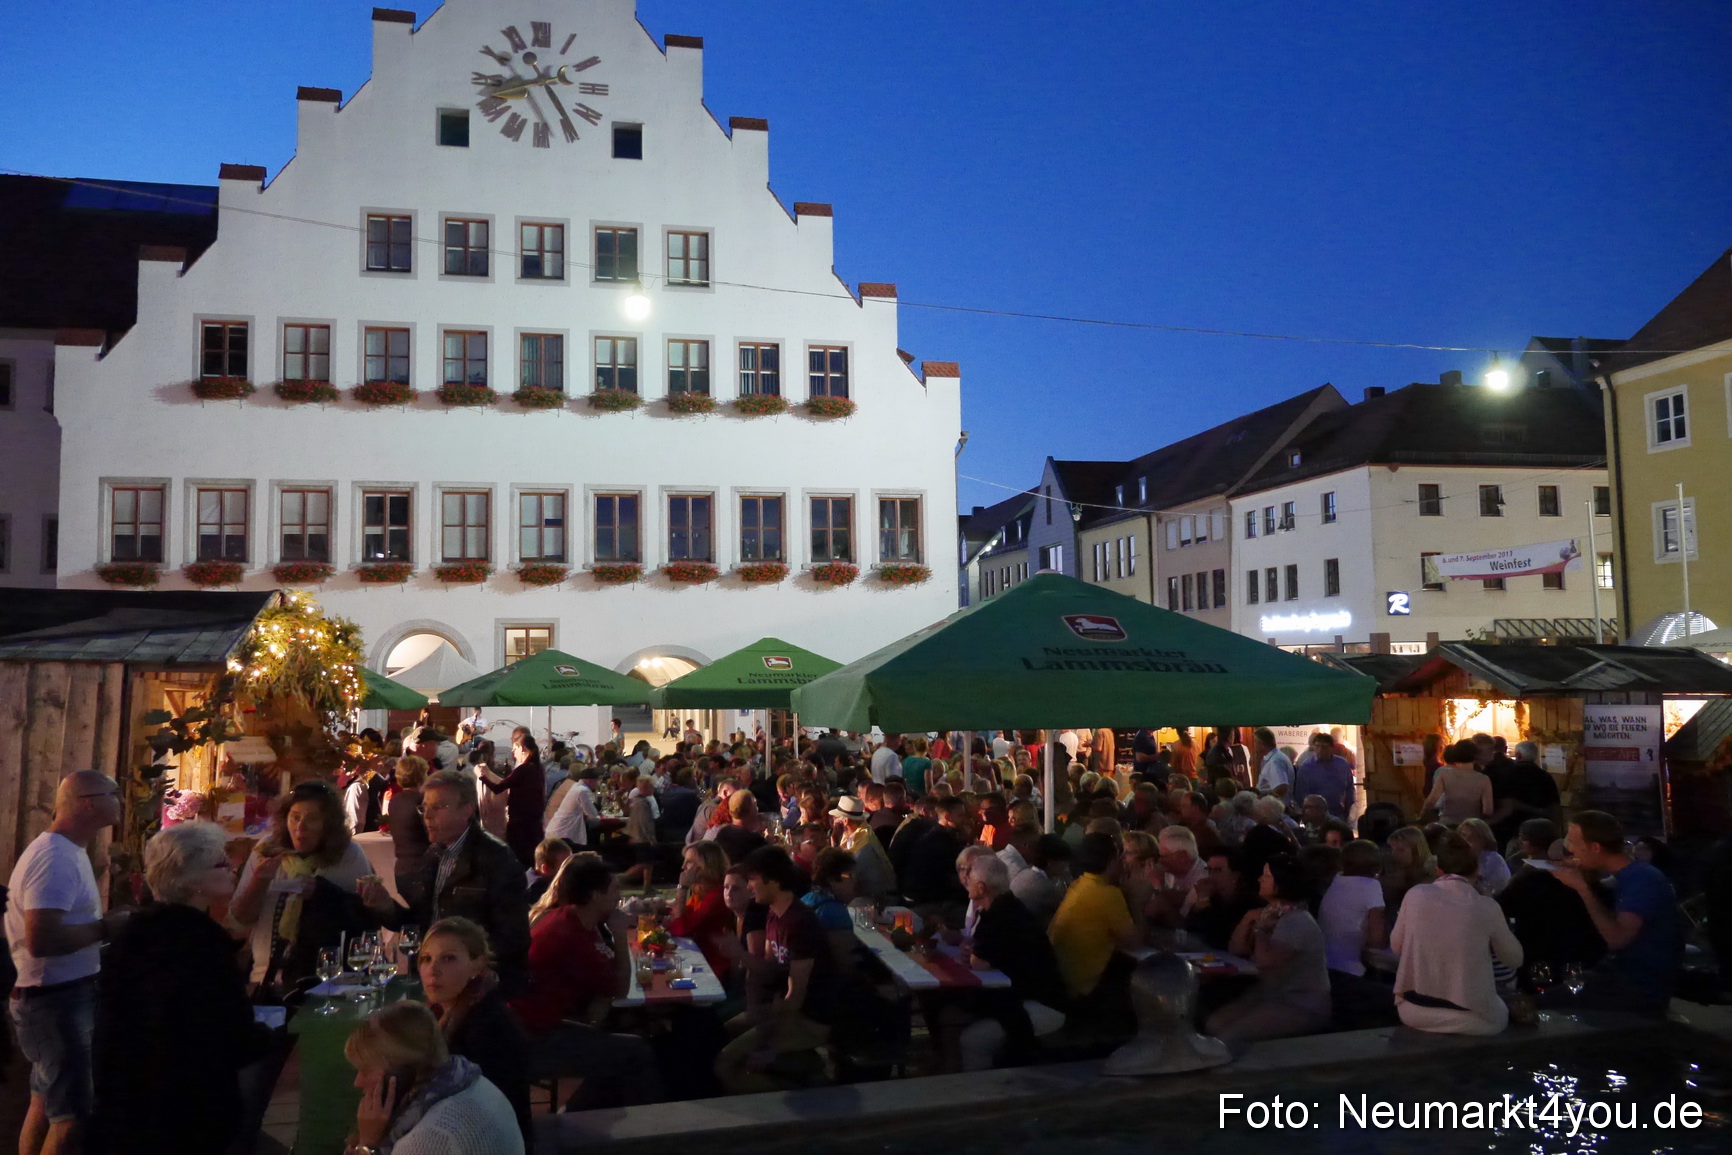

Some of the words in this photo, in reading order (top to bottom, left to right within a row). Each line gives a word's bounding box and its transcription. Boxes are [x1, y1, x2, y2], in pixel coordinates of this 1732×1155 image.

[1448, 555, 1459, 563] und
[1466, 553, 1497, 563] September
[1498, 551, 1513, 559] 2013
[1490, 558, 1531, 571] Weinfest
[1388, 593, 1410, 614] R
[1043, 647, 1187, 659] Neumarkter
[1020, 657, 1228, 673] Lammsbräu
[1621, 716, 1647, 724] WANN
[1277, 730, 1308, 738] WABERER
[1608, 724, 1619, 732] SIE
[1621, 724, 1647, 732] FEIERN
